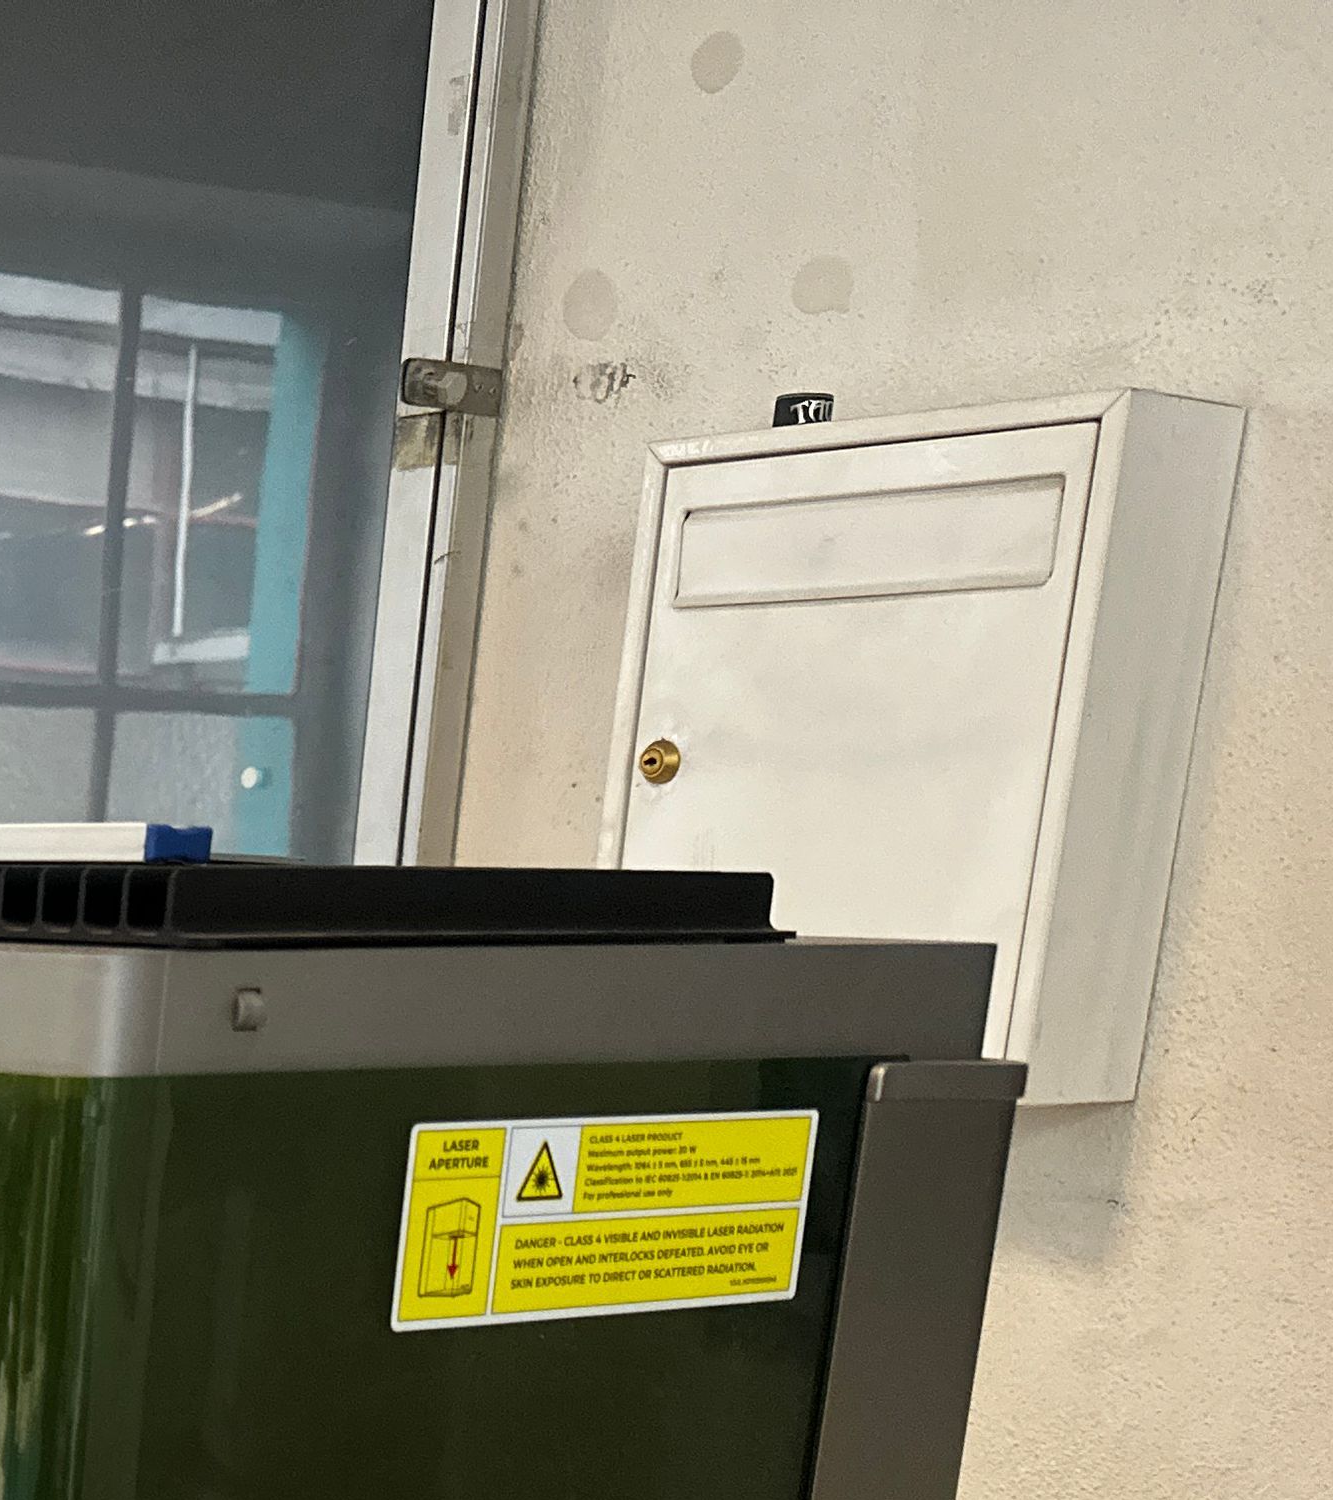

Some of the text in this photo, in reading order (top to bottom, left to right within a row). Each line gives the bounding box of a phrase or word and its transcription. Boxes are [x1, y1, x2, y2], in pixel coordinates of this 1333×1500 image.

[443, 1139, 479, 1152] LASER
[589, 1135, 613, 1144] CLASS
[621, 1133, 646, 1143] LASER
[647, 1132, 683, 1141] PRODUCT
[429, 1156, 489, 1170] APERTURE
[515, 1237, 556, 1250] DANGER
[563, 1234, 593, 1247] CLASS
[596, 1234, 601, 1244] 4
[604, 1231, 638, 1244] VISIBLE
[640, 1230, 661, 1241] AND
[662, 1227, 706, 1240] INVISIBLE
[707, 1225, 734, 1237] LASER
[737, 1222, 785, 1234] RADIATION
[513, 1242, 769, 1269] WHEN OPEN AND INTERLOCKS DEFEATED. AVOID EYE OR
[510, 1278, 533, 1290] SKIN
[535, 1273, 586, 1288] EXPOSURE
[589, 1273, 601, 1284] TO
[603, 1269, 636, 1283] DIRECT
[638, 1269, 652, 1280] OR
[653, 1265, 705, 1279] SCATTERED
